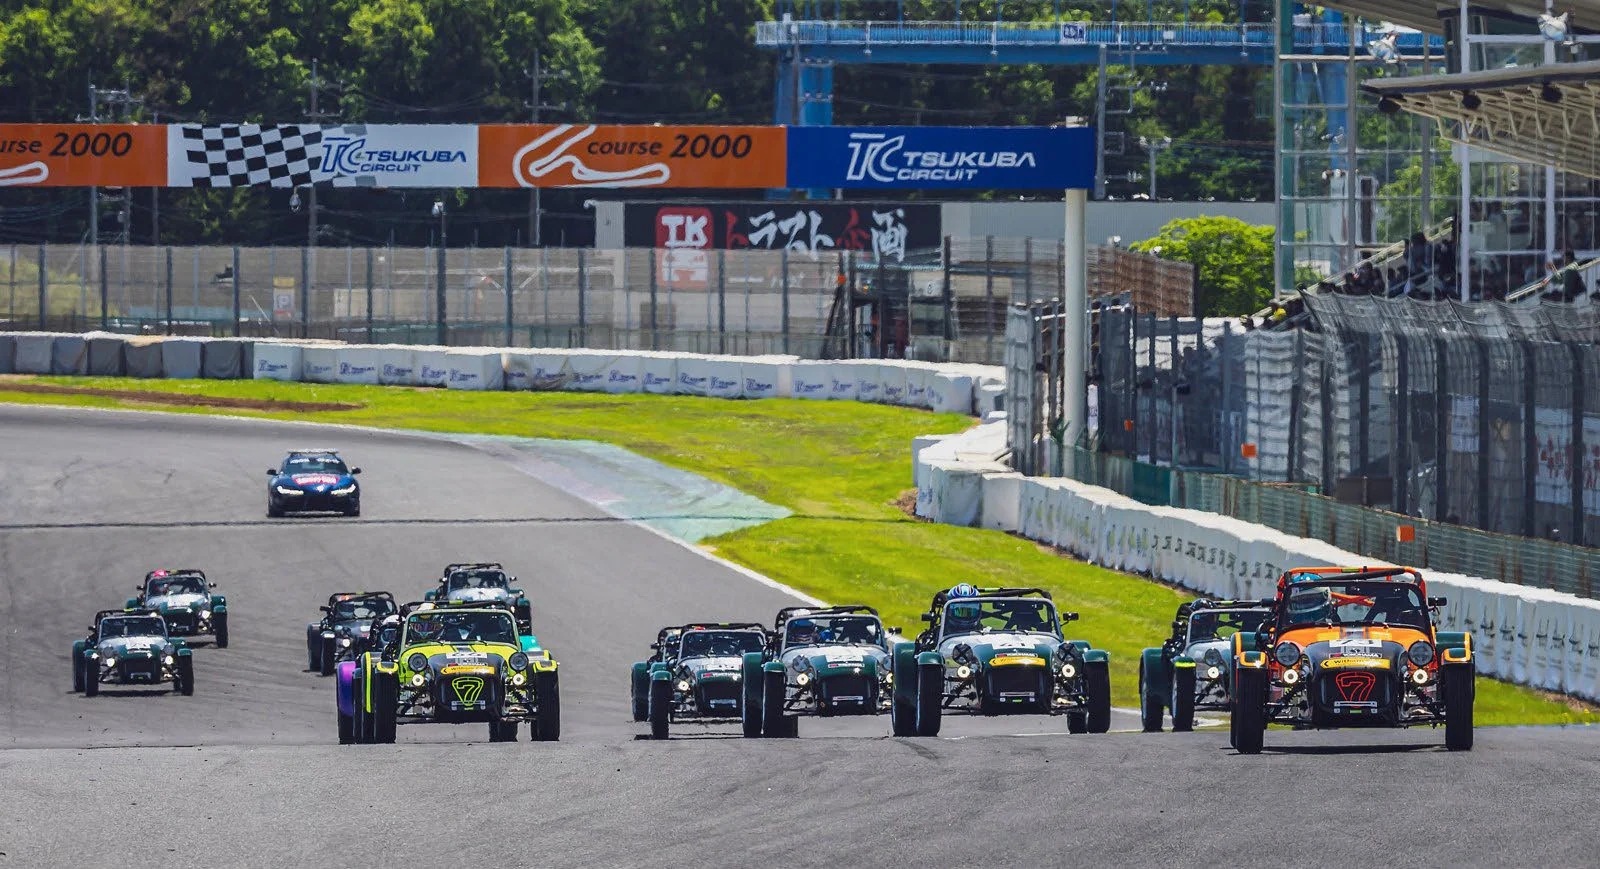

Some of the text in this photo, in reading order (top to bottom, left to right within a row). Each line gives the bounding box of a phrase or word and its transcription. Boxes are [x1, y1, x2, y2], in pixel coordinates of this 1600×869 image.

[49, 132, 133, 157] 2000
[366, 150, 467, 163] TSUKUBA
[587, 133, 753, 158] course 2000
[903, 151, 1037, 168] TSUKUBA
[456, 679, 480, 703] 7
[1341, 675, 1370, 703] 7
